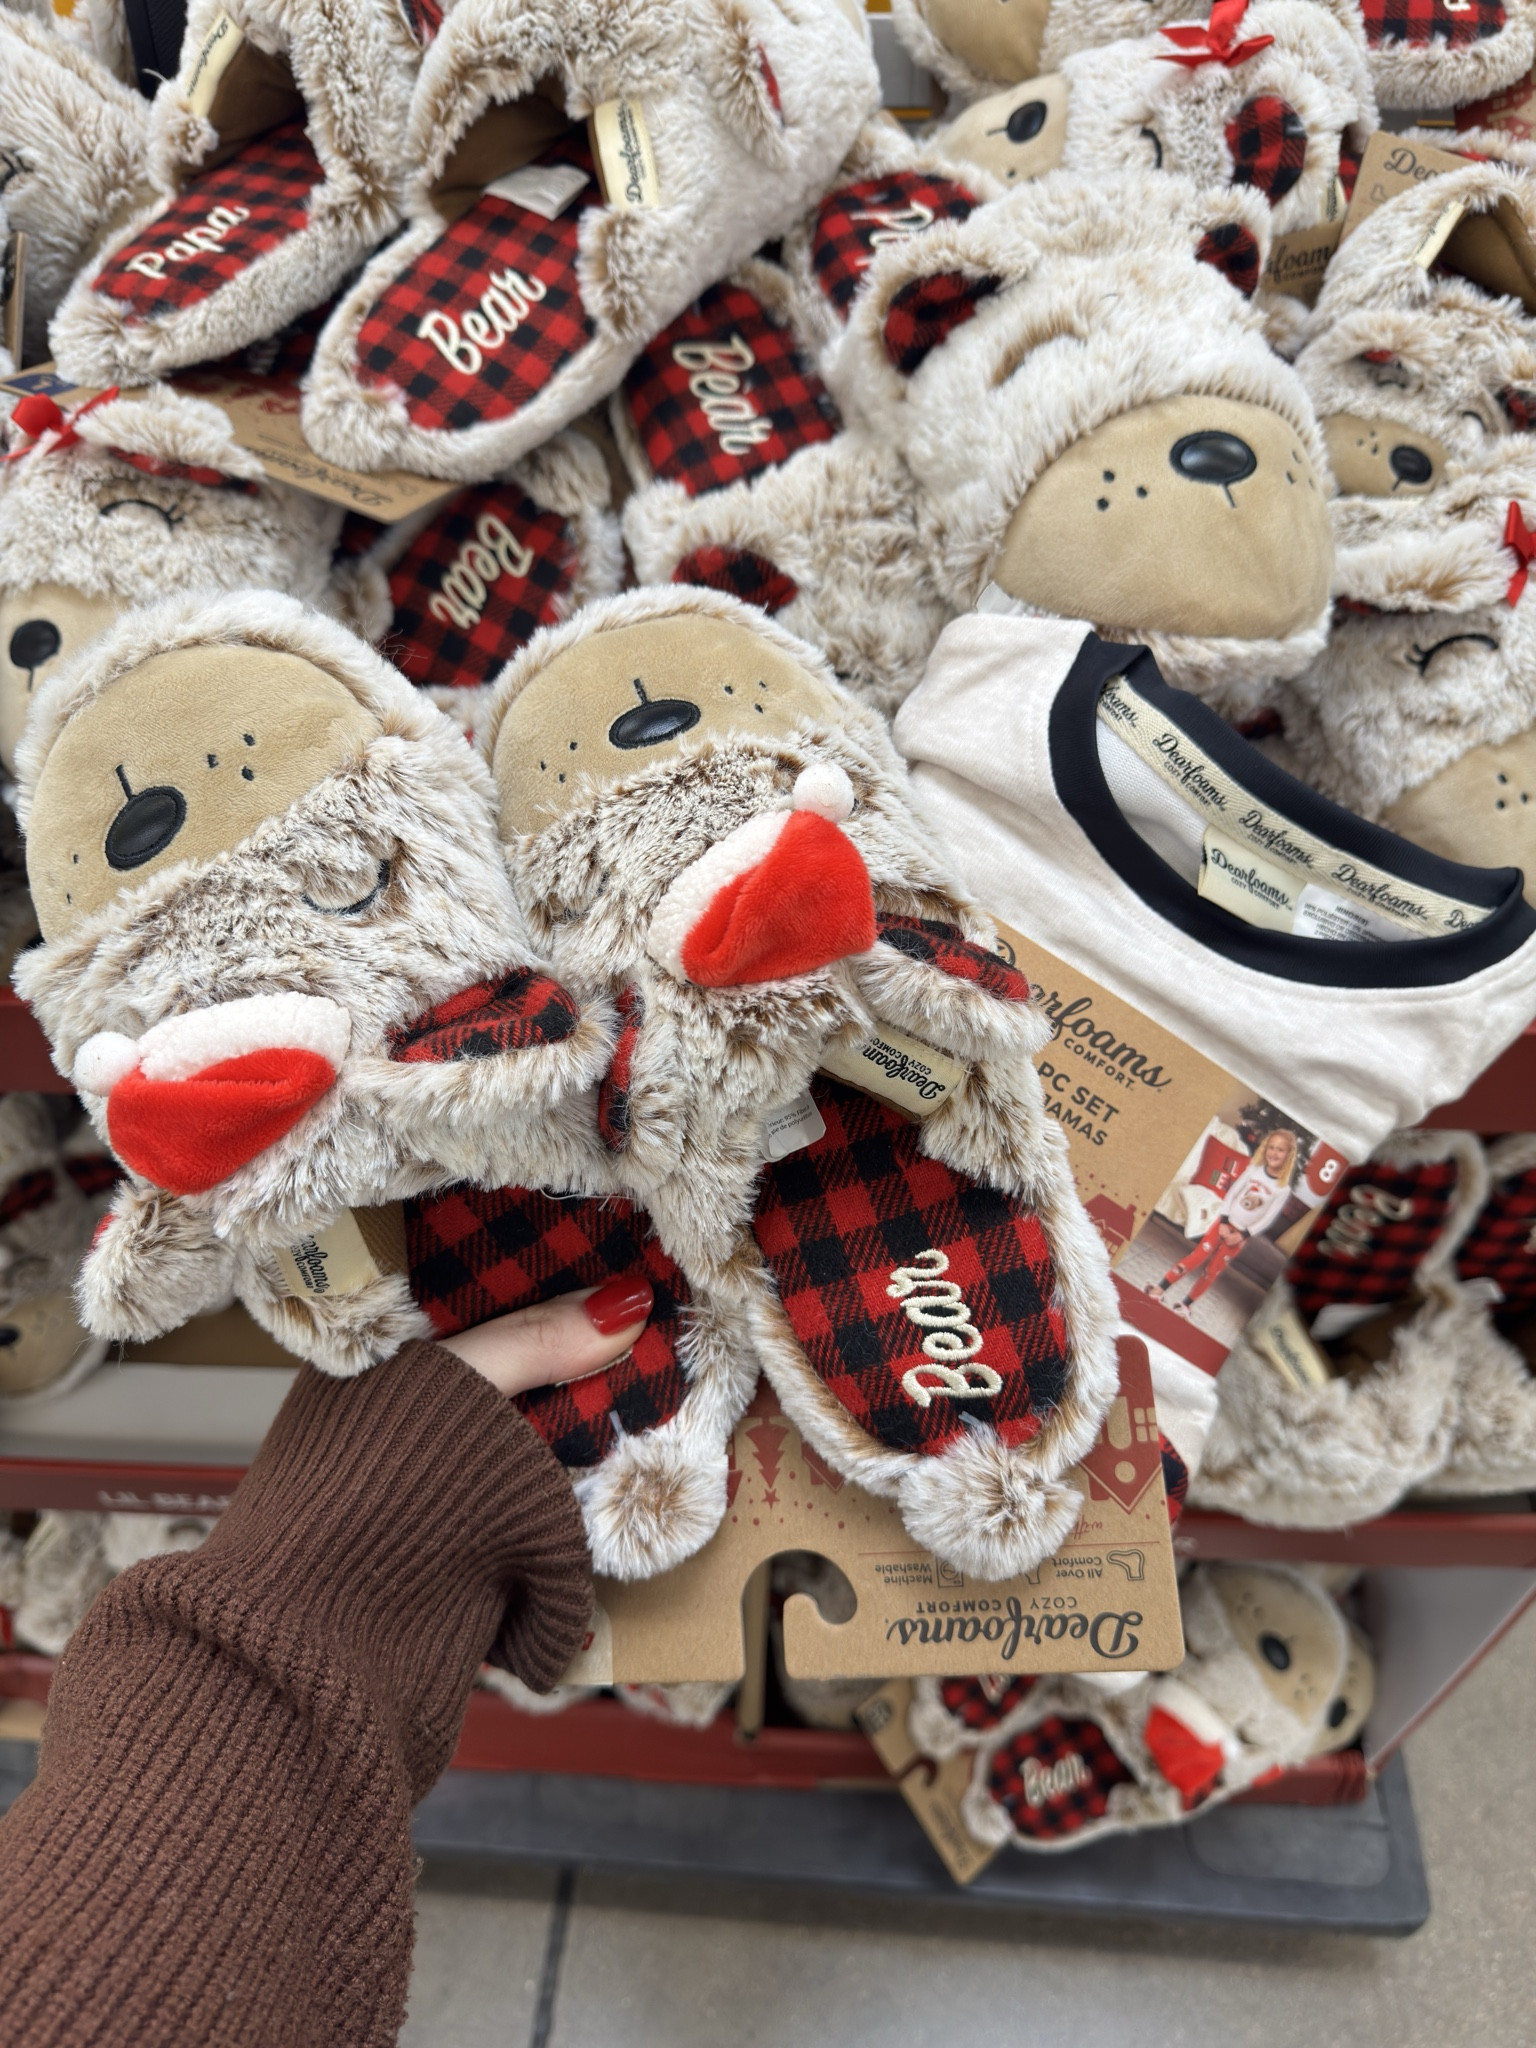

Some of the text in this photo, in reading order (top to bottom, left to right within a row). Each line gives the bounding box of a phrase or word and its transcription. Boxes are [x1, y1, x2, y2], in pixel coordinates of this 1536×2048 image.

[124, 205, 250, 279] Papa
[416, 267, 547, 375] Bear
[671, 331, 773, 455] Bear
[428, 513, 535, 630] Bear
[1152, 733, 1228, 808] Dearfoams
[1163, 761, 1180, 779] COZY
[1239, 809, 1315, 867] Dearfoams
[1211, 848, 1290, 906] Dearfoams
[1231, 876, 1281, 911] COZY COMFORT
[1332, 863, 1429, 919] Dearfoams
[859, 1045, 946, 1100] Dearfoam
[870, 1037, 932, 1076] COZY COMFO
[1063, 1038, 1135, 1089] COMFORT
[1071, 1086, 1120, 1124] SET
[1318, 1158, 1339, 1183] 8
[886, 1249, 1003, 1407] Bear
[875, 1562, 932, 1574] Washable
[884, 1574, 932, 1585] Machine
[1052, 1556, 1102, 1569] Comfort
[1056, 1567, 1103, 1579] All Over
[887, 1596, 1143, 1660] Dearfoams
[916, 1596, 1077, 1613] COZY COMFORT
